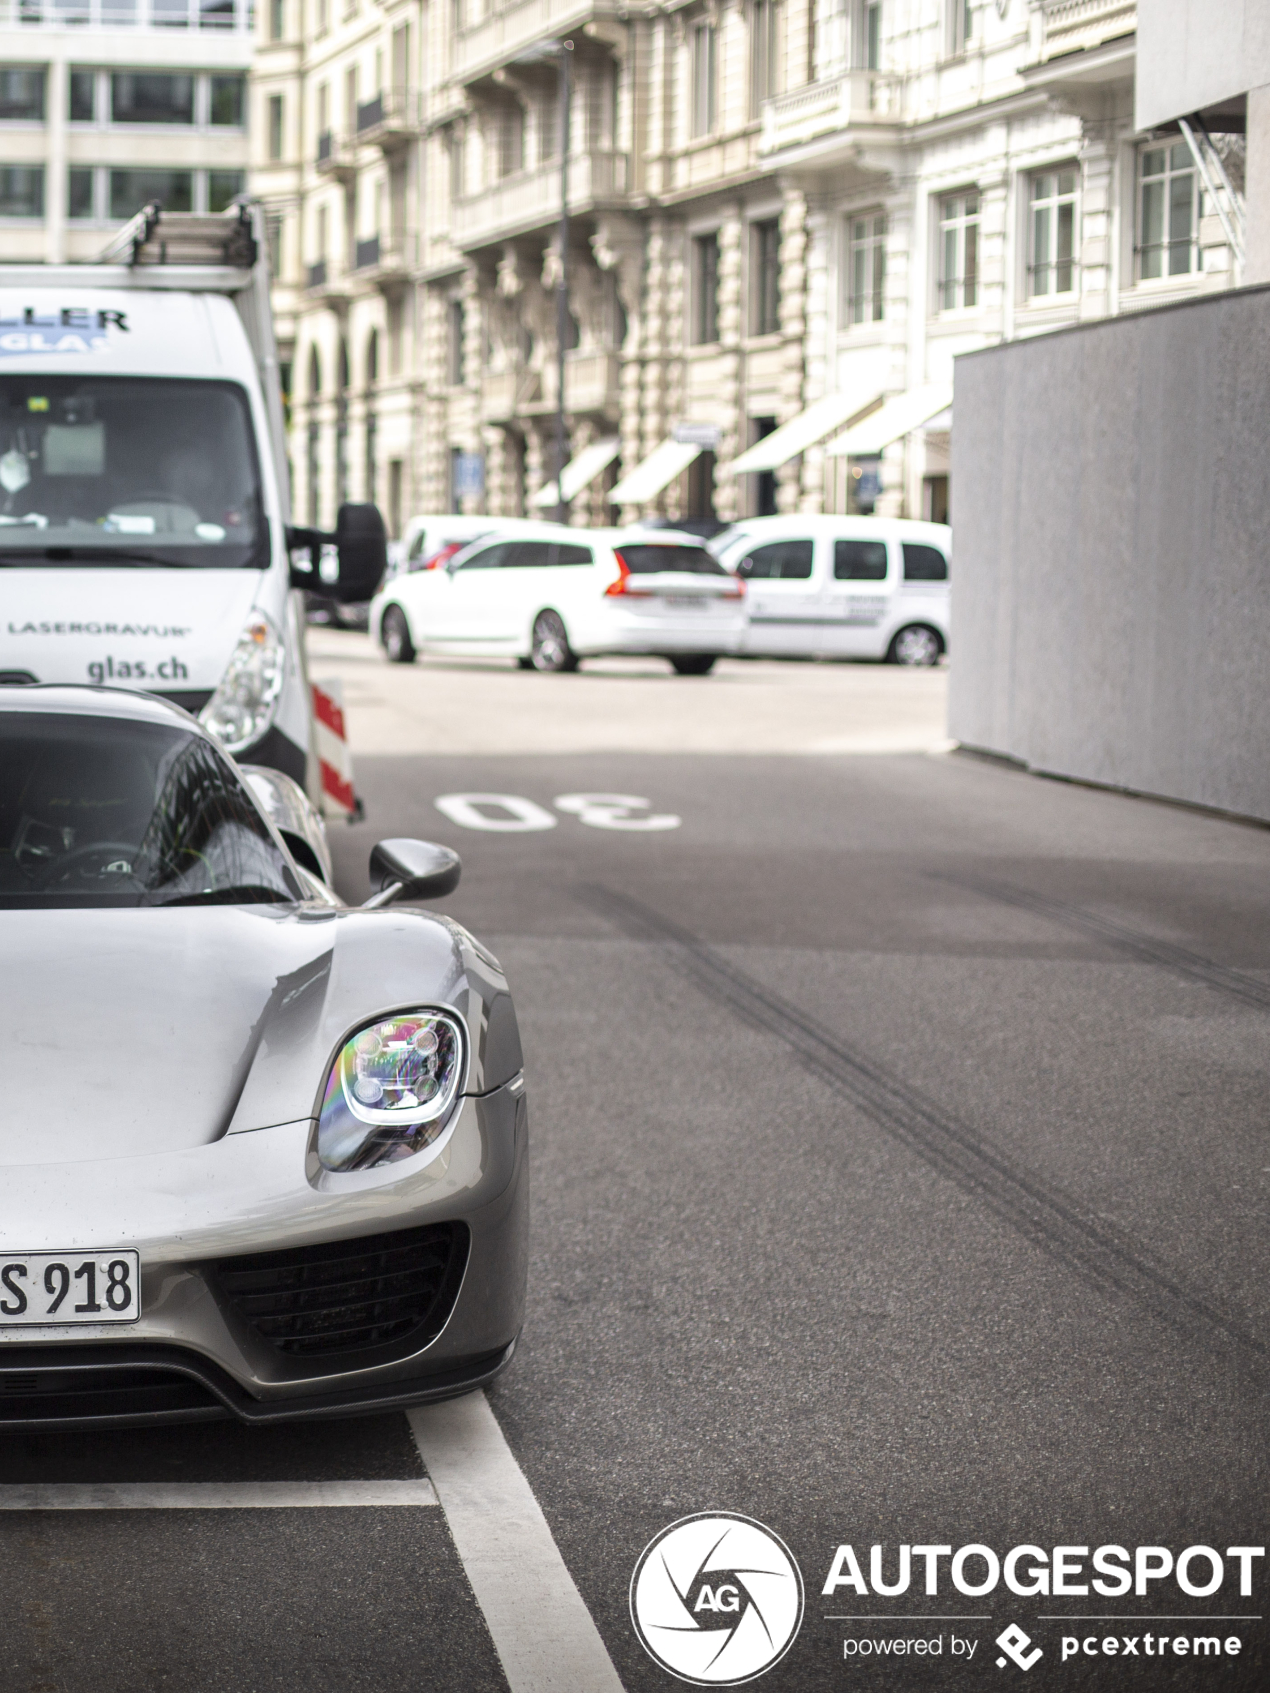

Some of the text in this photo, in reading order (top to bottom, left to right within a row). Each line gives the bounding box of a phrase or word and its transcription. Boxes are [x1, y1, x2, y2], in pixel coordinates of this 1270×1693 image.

[87, 656, 189, 685] glas.ch
[433, 791, 682, 833] 30
[43, 1259, 131, 1314] 918
